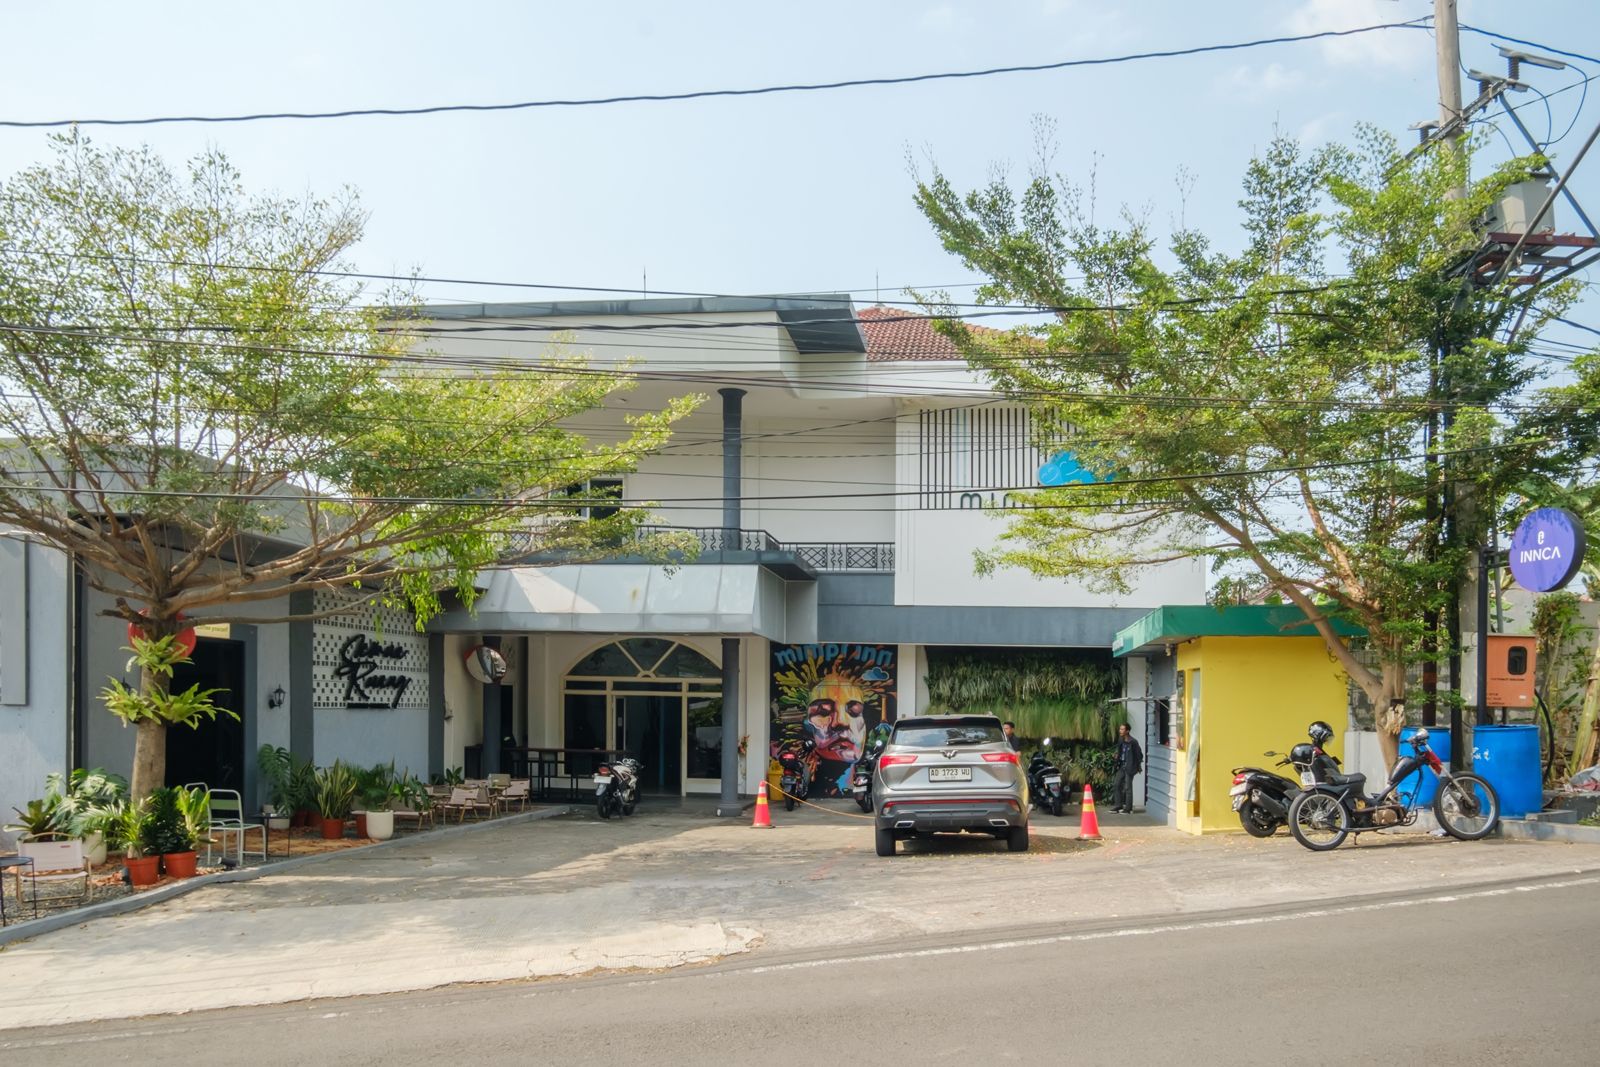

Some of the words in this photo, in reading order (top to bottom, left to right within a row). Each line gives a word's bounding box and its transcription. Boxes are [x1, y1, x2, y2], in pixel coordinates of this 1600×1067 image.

[1520, 546, 1561, 563] INNCA
[774, 643, 849, 666] mimpi
[852, 644, 893, 666] inn
[931, 769, 939, 777] AD
